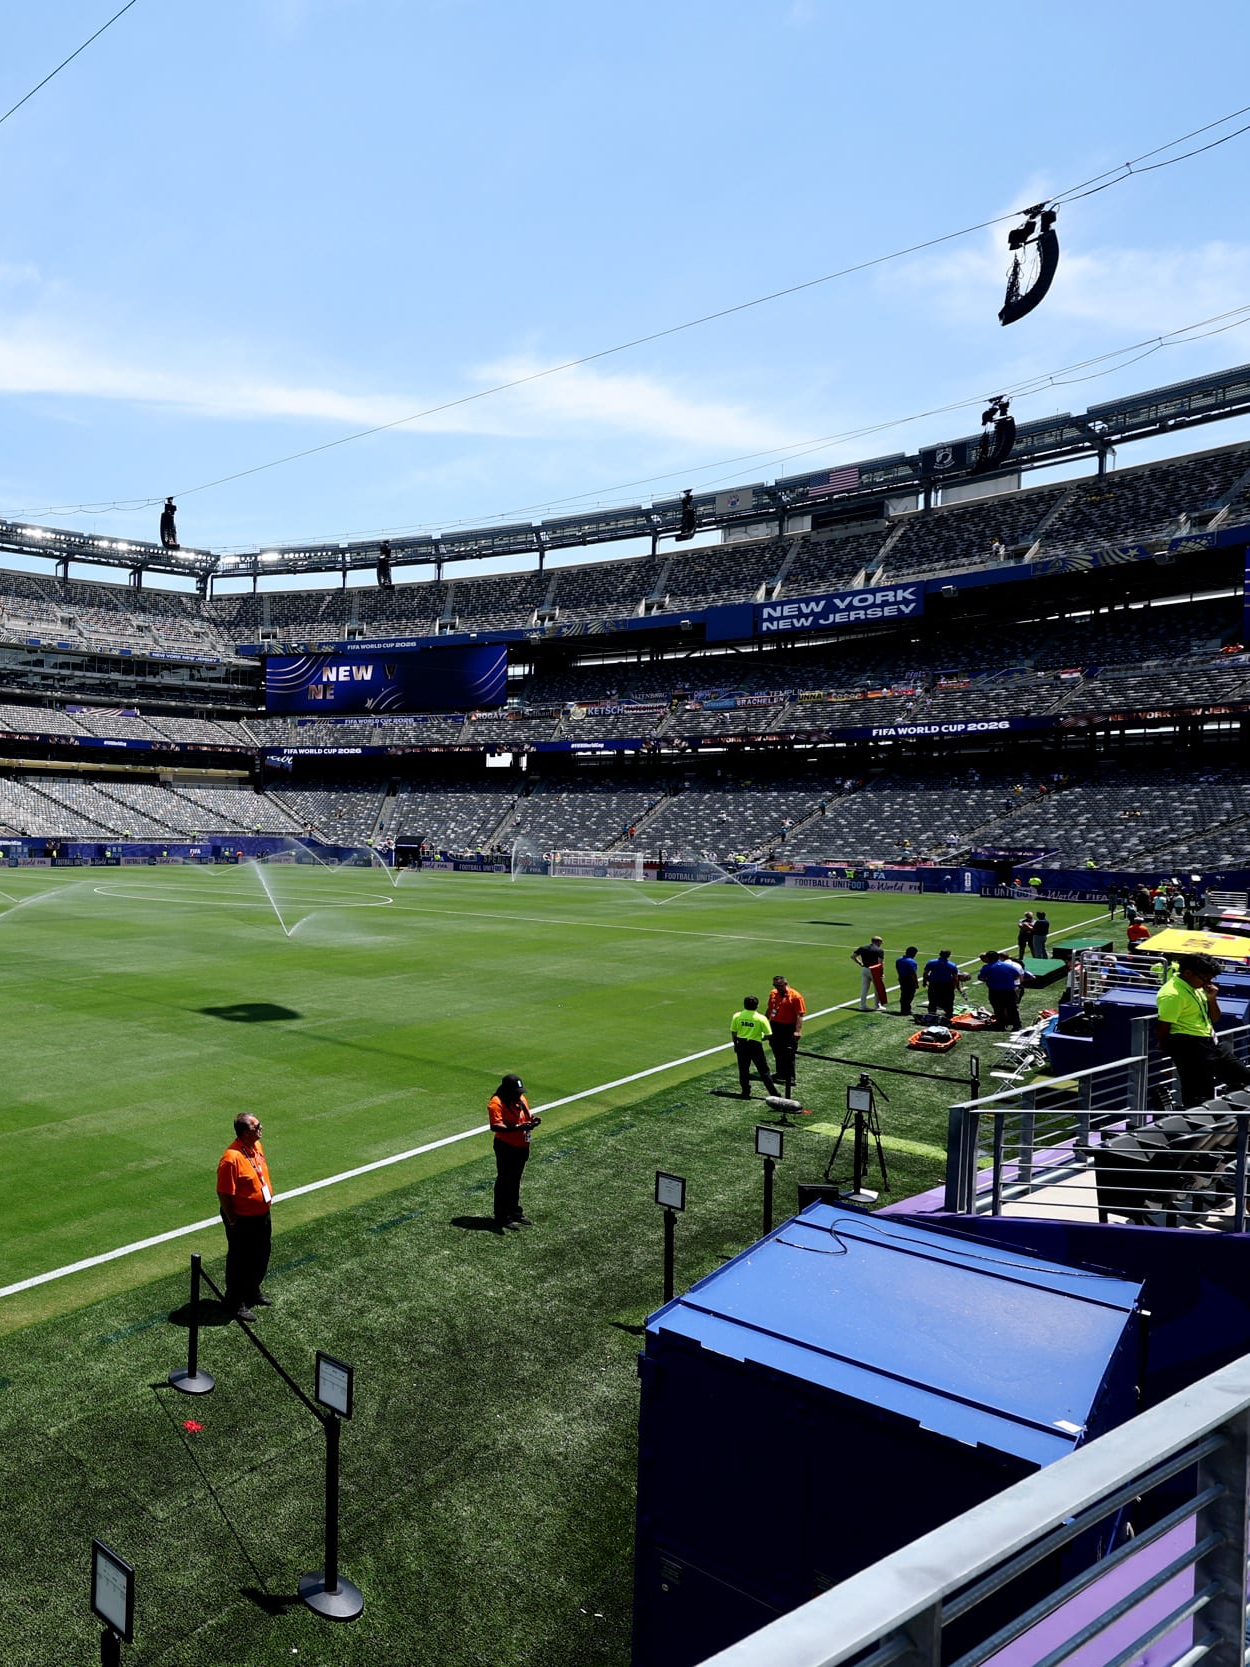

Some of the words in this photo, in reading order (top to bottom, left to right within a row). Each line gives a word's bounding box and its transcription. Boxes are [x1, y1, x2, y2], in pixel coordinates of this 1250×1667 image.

[762, 600, 827, 619] NEW
[833, 587, 918, 609] YORK
[762, 616, 814, 631] NEW
[819, 603, 917, 625] JERSEY
[322, 665, 374, 682] NEW
[588, 706, 625, 715] KETSCH
[872, 728, 896, 736] FIFA
[898, 726, 940, 735] WORLD
[941, 724, 965, 733] CUP
[967, 721, 1010, 731] 2026
[665, 873, 694, 881] FOOTBALL
[863, 871, 886, 879] FFA
[794, 878, 830, 888] FOOTBALL
[877, 881, 903, 891] World
